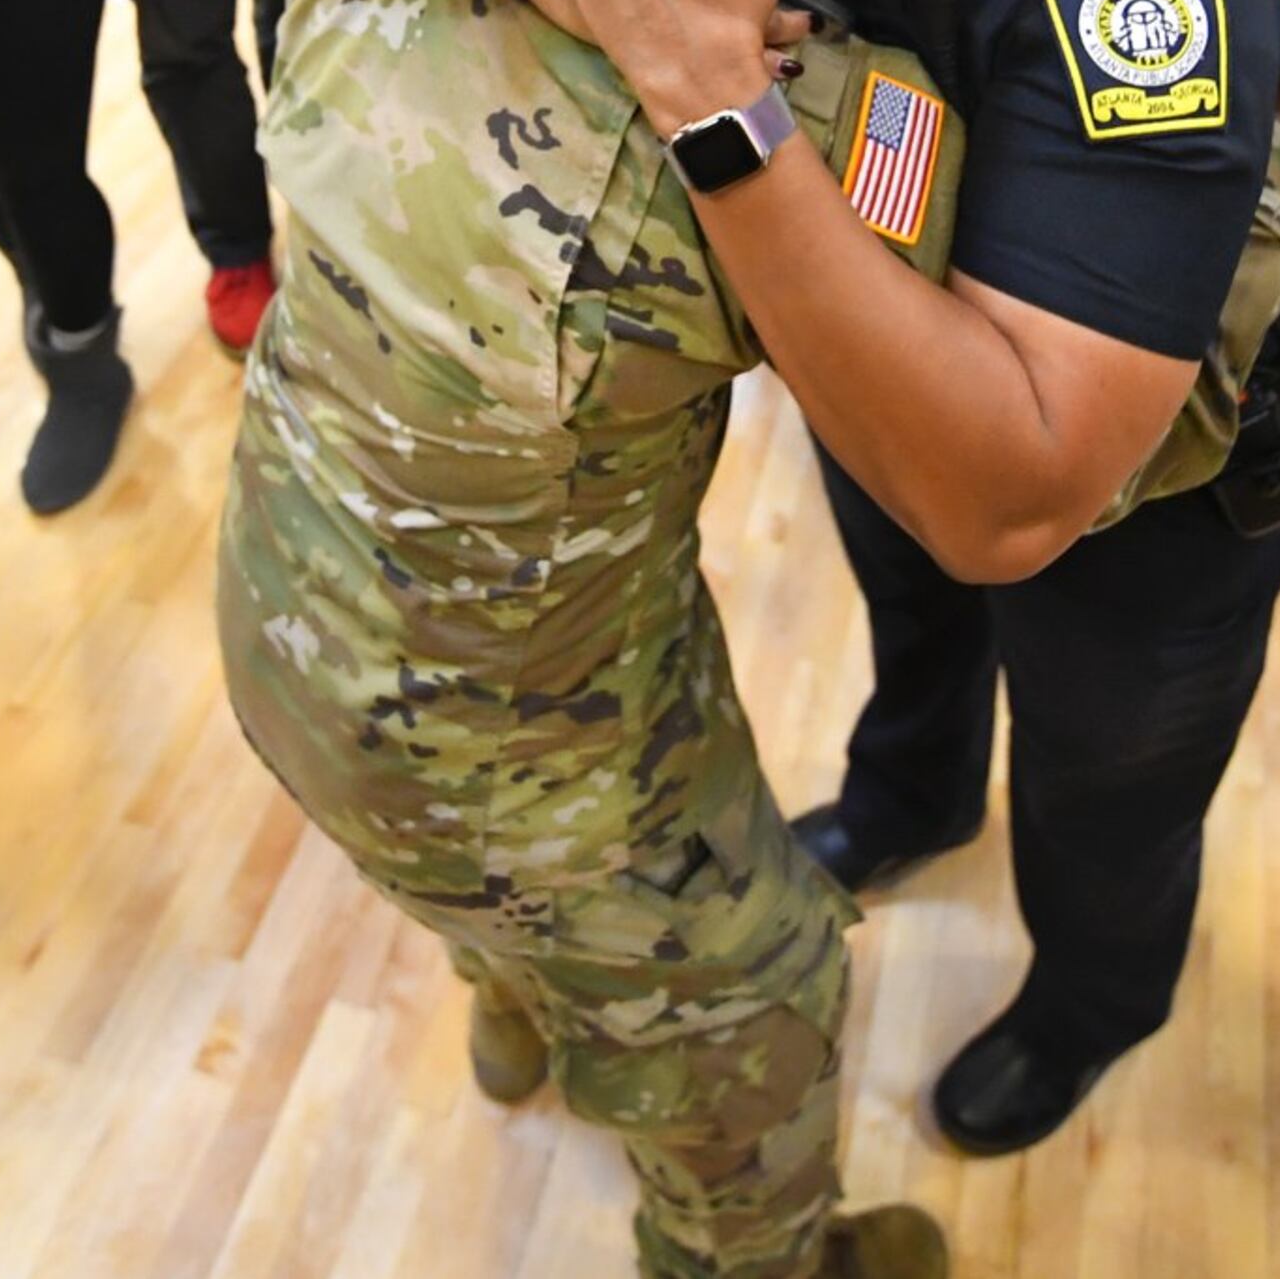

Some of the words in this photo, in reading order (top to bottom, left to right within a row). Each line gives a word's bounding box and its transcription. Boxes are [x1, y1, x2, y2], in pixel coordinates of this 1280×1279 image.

[1088, 42, 1131, 81] ATLANTA
[1131, 67, 1174, 85] PUBLIC
[1096, 93, 1142, 108] ATLANTA
